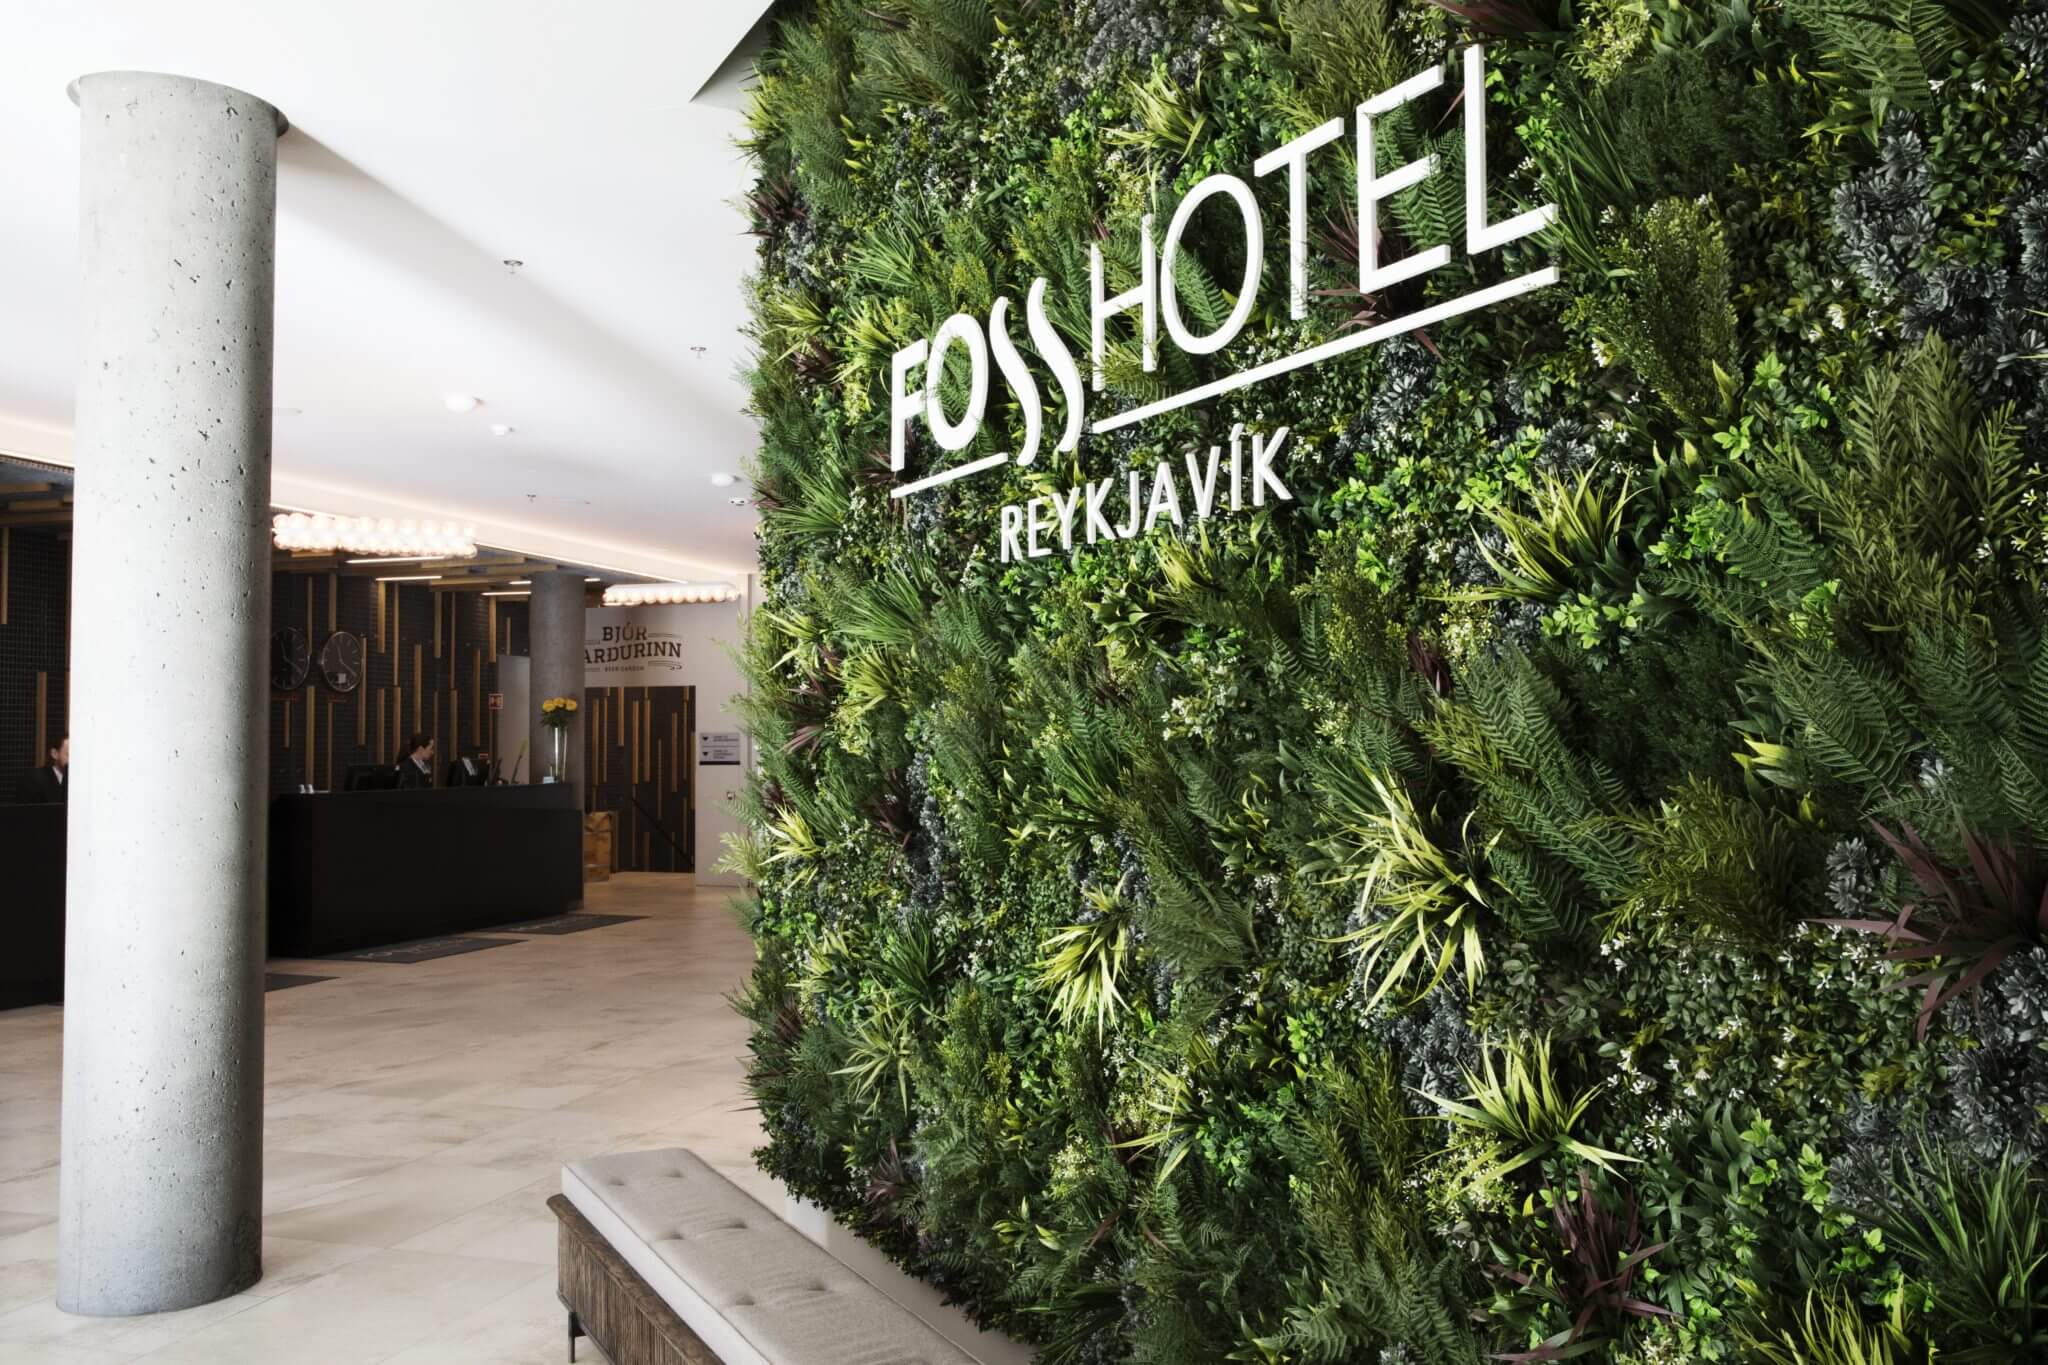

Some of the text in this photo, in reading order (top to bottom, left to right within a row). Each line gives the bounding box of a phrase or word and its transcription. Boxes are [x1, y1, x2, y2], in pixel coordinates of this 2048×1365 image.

[890, 44, 1558, 471] FOSSHOTEL
[1001, 423, 1292, 562] REYKJAVÍK
[602, 622, 648, 643] BJÓR
